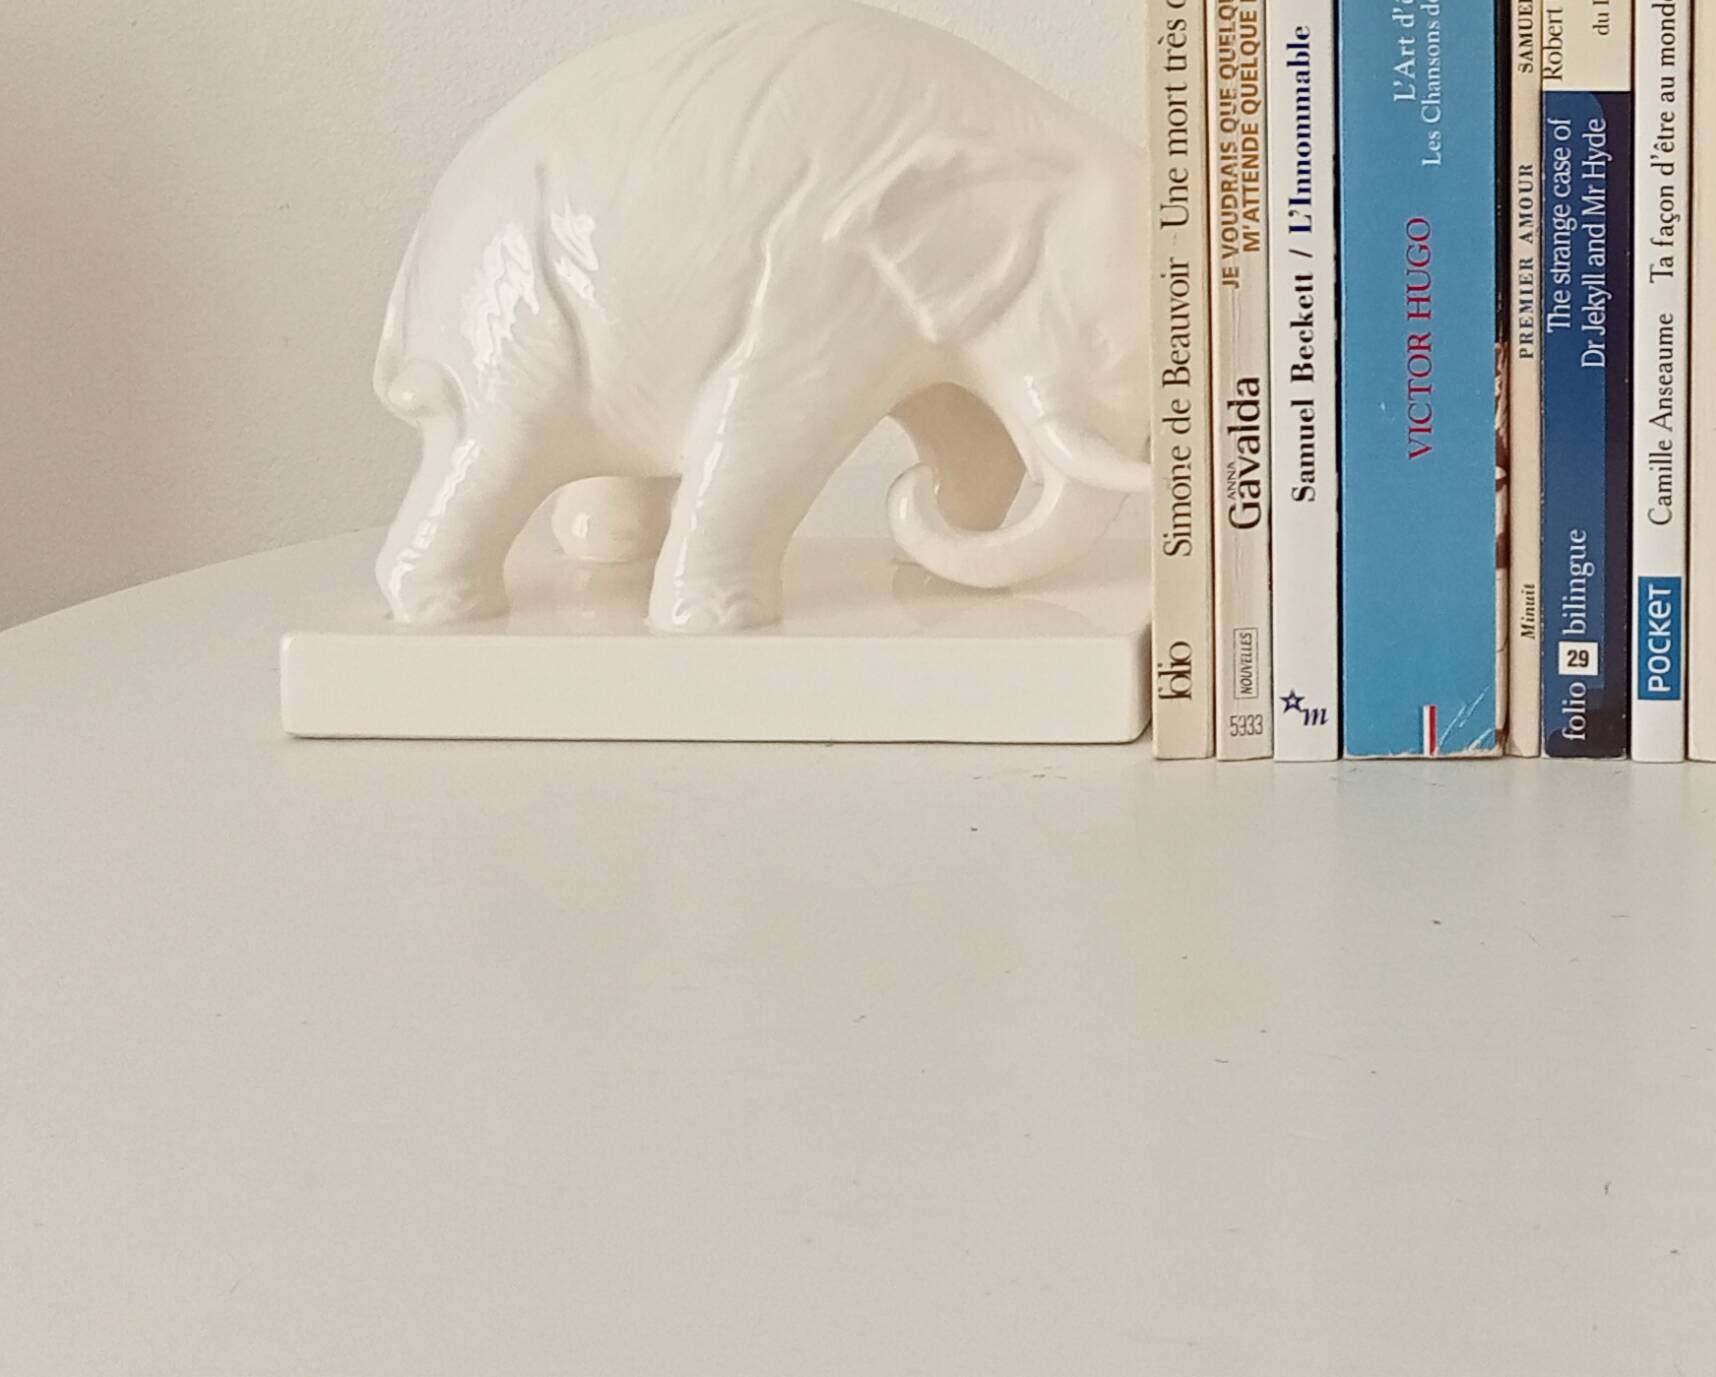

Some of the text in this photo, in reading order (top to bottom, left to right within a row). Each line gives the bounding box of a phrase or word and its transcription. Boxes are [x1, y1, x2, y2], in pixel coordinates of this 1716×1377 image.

[1158, 19, 1187, 72] très
[1542, 7, 1564, 81] Robert
[1592, 9, 1611, 36] du
[1240, 10, 1260, 115] QUELQUE
[1420, 21, 1441, 123] Chansons
[1658, 76, 1675, 103] au
[1163, 84, 1188, 156] mort
[1219, 89, 1240, 132] QUE
[1422, 131, 1441, 165] Les
[1160, 168, 1189, 227] Une
[1218, 142, 1239, 258] VOUDRAIS
[1240, 122, 1260, 252] M'ATTENDE
[1650, 185, 1681, 246] façon
[1546, 117, 1575, 332] The strange case of
[1581, 119, 1611, 367] Dr Jekyll and Mr Hyde
[1221, 266, 1239, 289] JE
[1517, 163, 1535, 359] PREMIER AMOUR
[1649, 255, 1674, 283] Ta
[1160, 257, 1191, 387] Beauvoir
[1289, 274, 1314, 383] Beckett
[1406, 217, 1432, 459] VICTOR HUGO
[1648, 313, 1673, 432] Anseaume
[1162, 399, 1191, 434] de
[1292, 399, 1316, 502] Samuel
[1226, 461, 1237, 500] ANNA
[1227, 377, 1260, 529] Gavalda
[1649, 440, 1673, 525] Camille
[1163, 446, 1192, 557] Simone
[1520, 584, 1537, 640] Minuit
[1564, 529, 1590, 635] bilingue
[1159, 641, 1192, 701] folio
[1238, 632, 1254, 695] NOUVELLES
[1566, 649, 1590, 668] 29
[1230, 715, 1264, 736] 5333
[1562, 682, 1587, 741] folio
